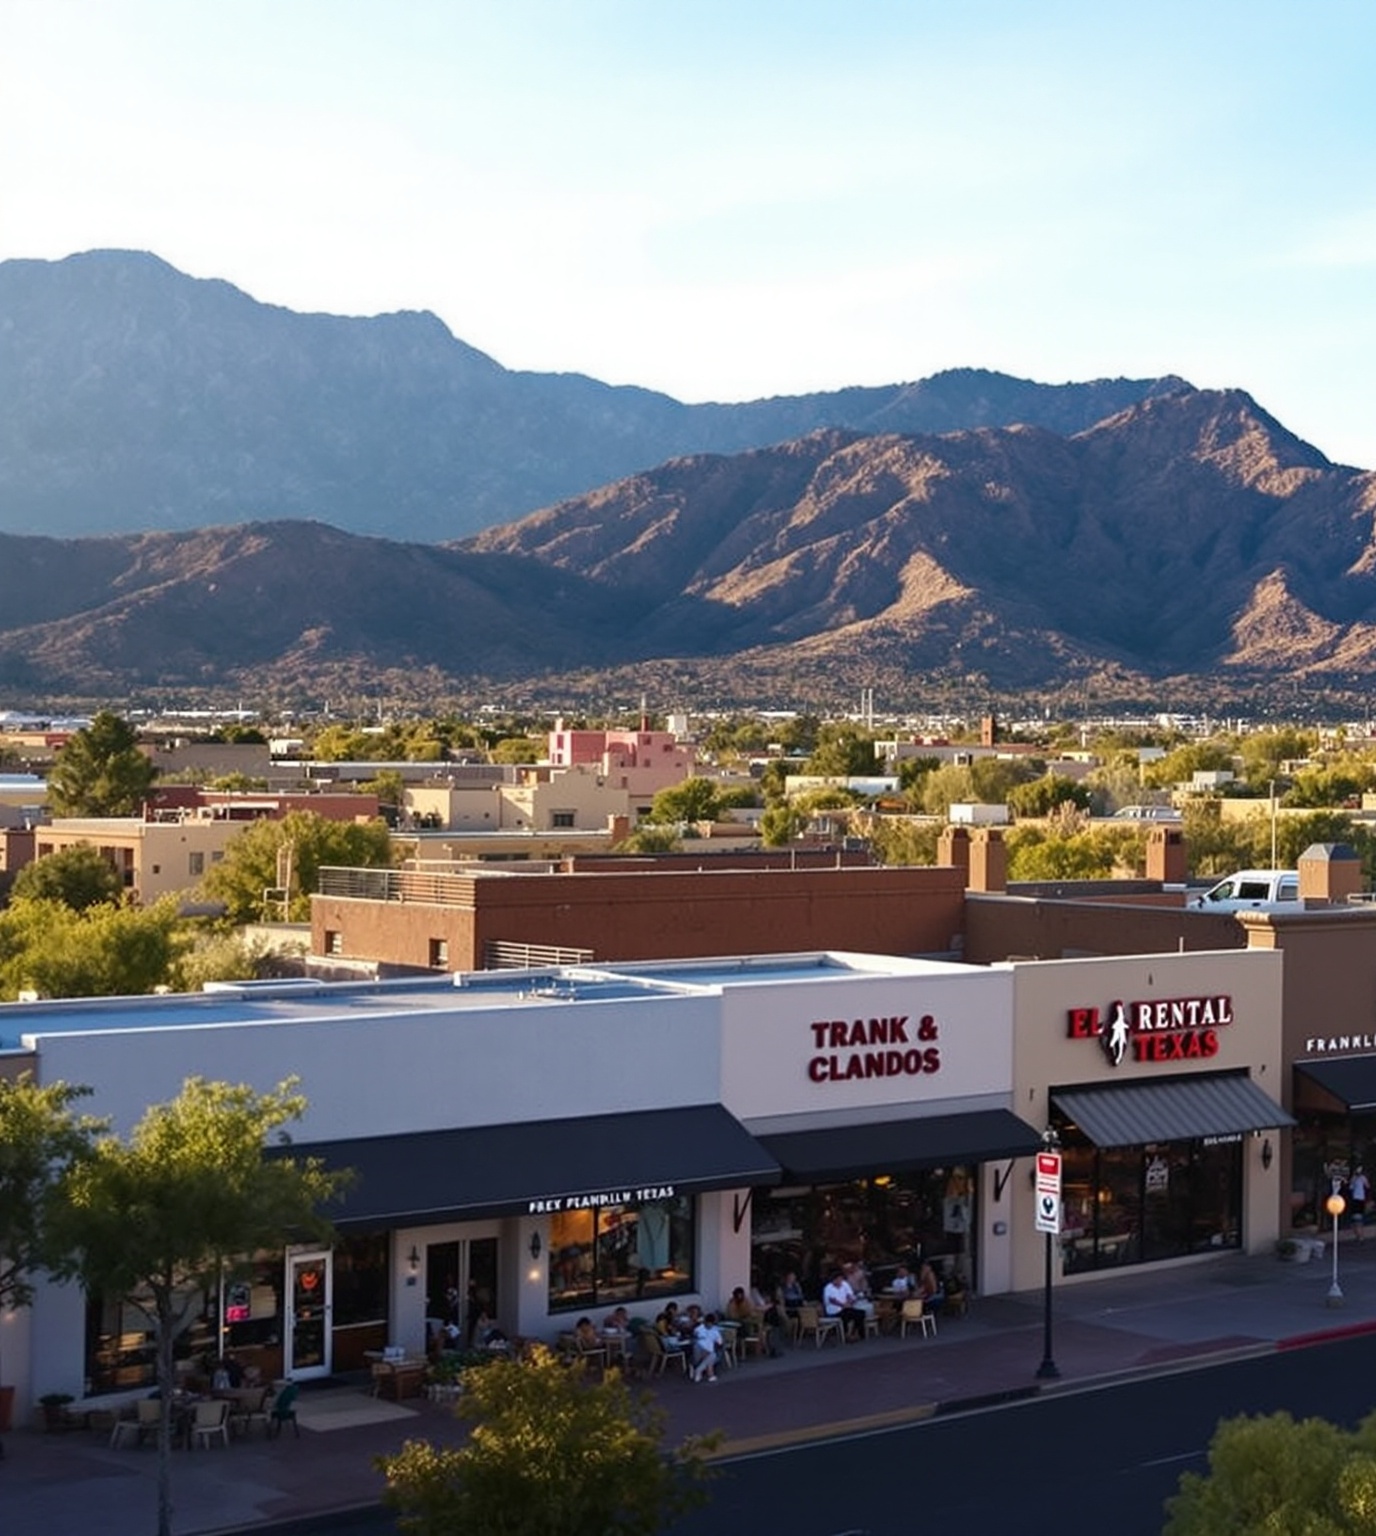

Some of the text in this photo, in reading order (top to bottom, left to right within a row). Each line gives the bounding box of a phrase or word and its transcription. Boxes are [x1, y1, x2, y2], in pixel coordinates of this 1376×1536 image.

[810, 1014, 939, 1049] TRANK &
[1068, 998, 1232, 1039] EL RENTAL
[1133, 1028, 1220, 1063] TEXAS
[808, 1047, 941, 1083] CLANDOS
